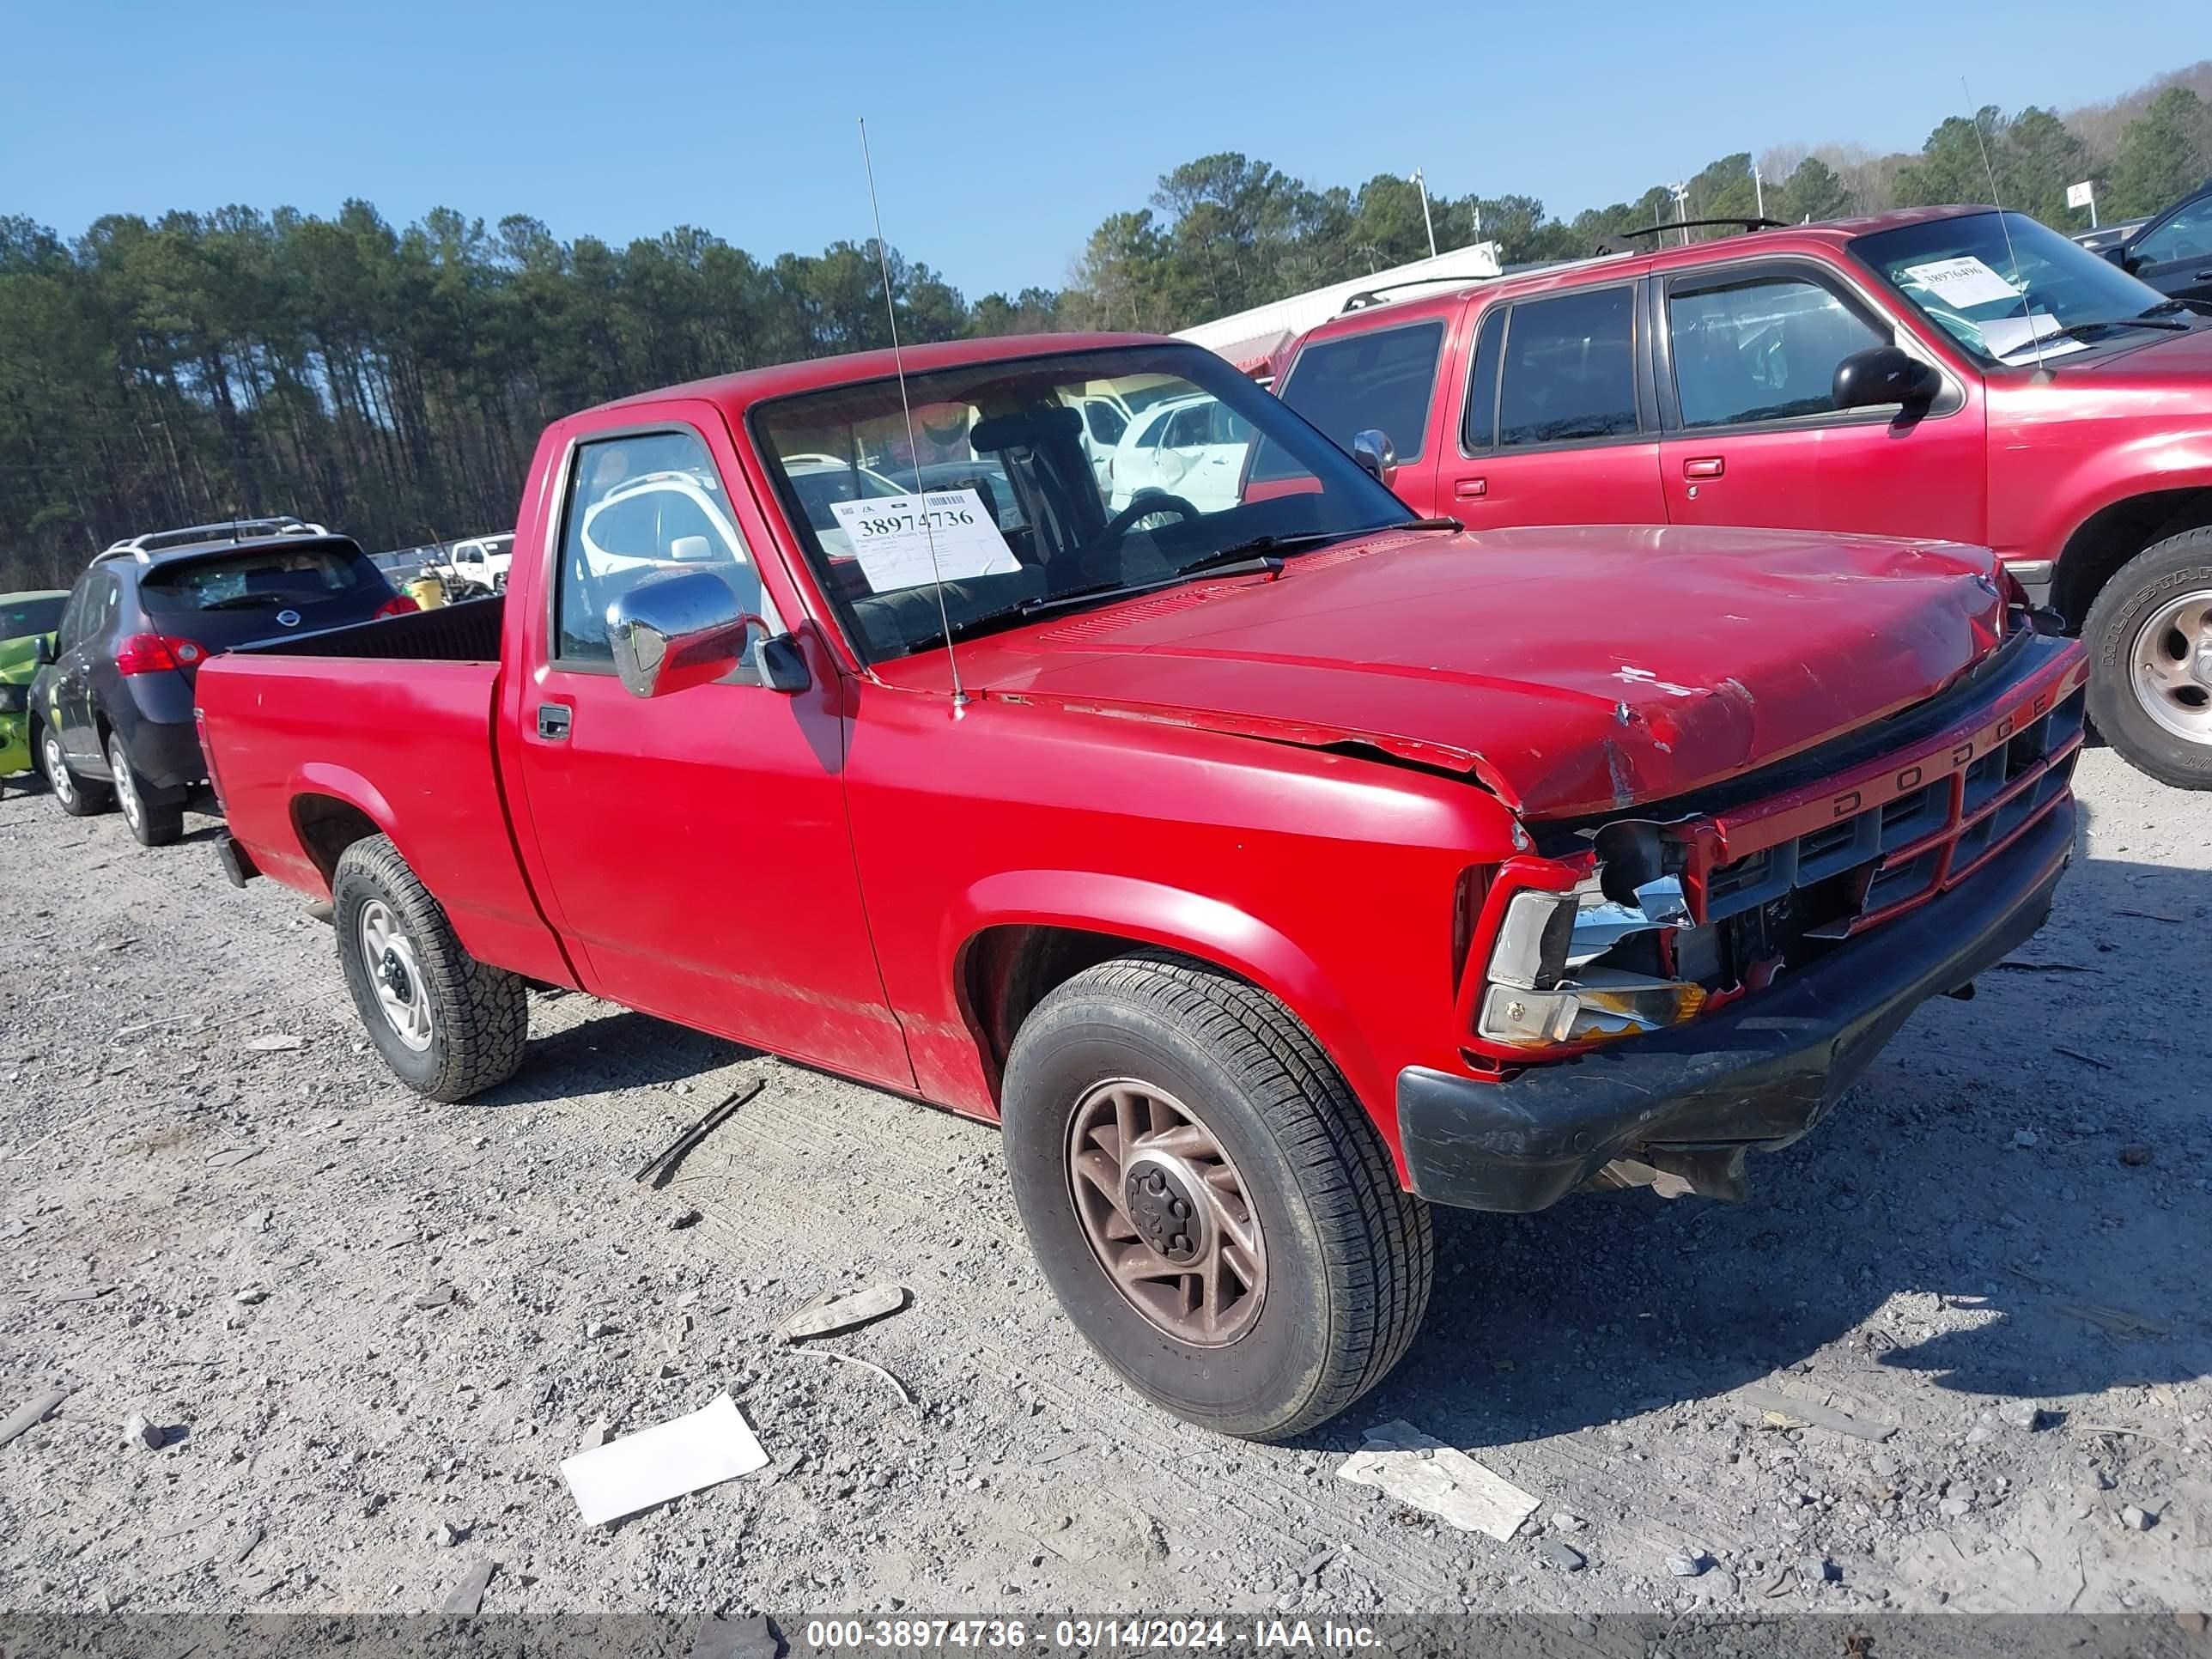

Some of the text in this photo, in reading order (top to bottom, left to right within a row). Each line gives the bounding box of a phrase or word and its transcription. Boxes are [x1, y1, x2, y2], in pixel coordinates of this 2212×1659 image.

[1923, 266, 1984, 284] 38976496
[858, 508, 975, 538] 38974736
[918, 527, 947, 536] Insrance
[1833, 694, 2048, 817] DODGE
